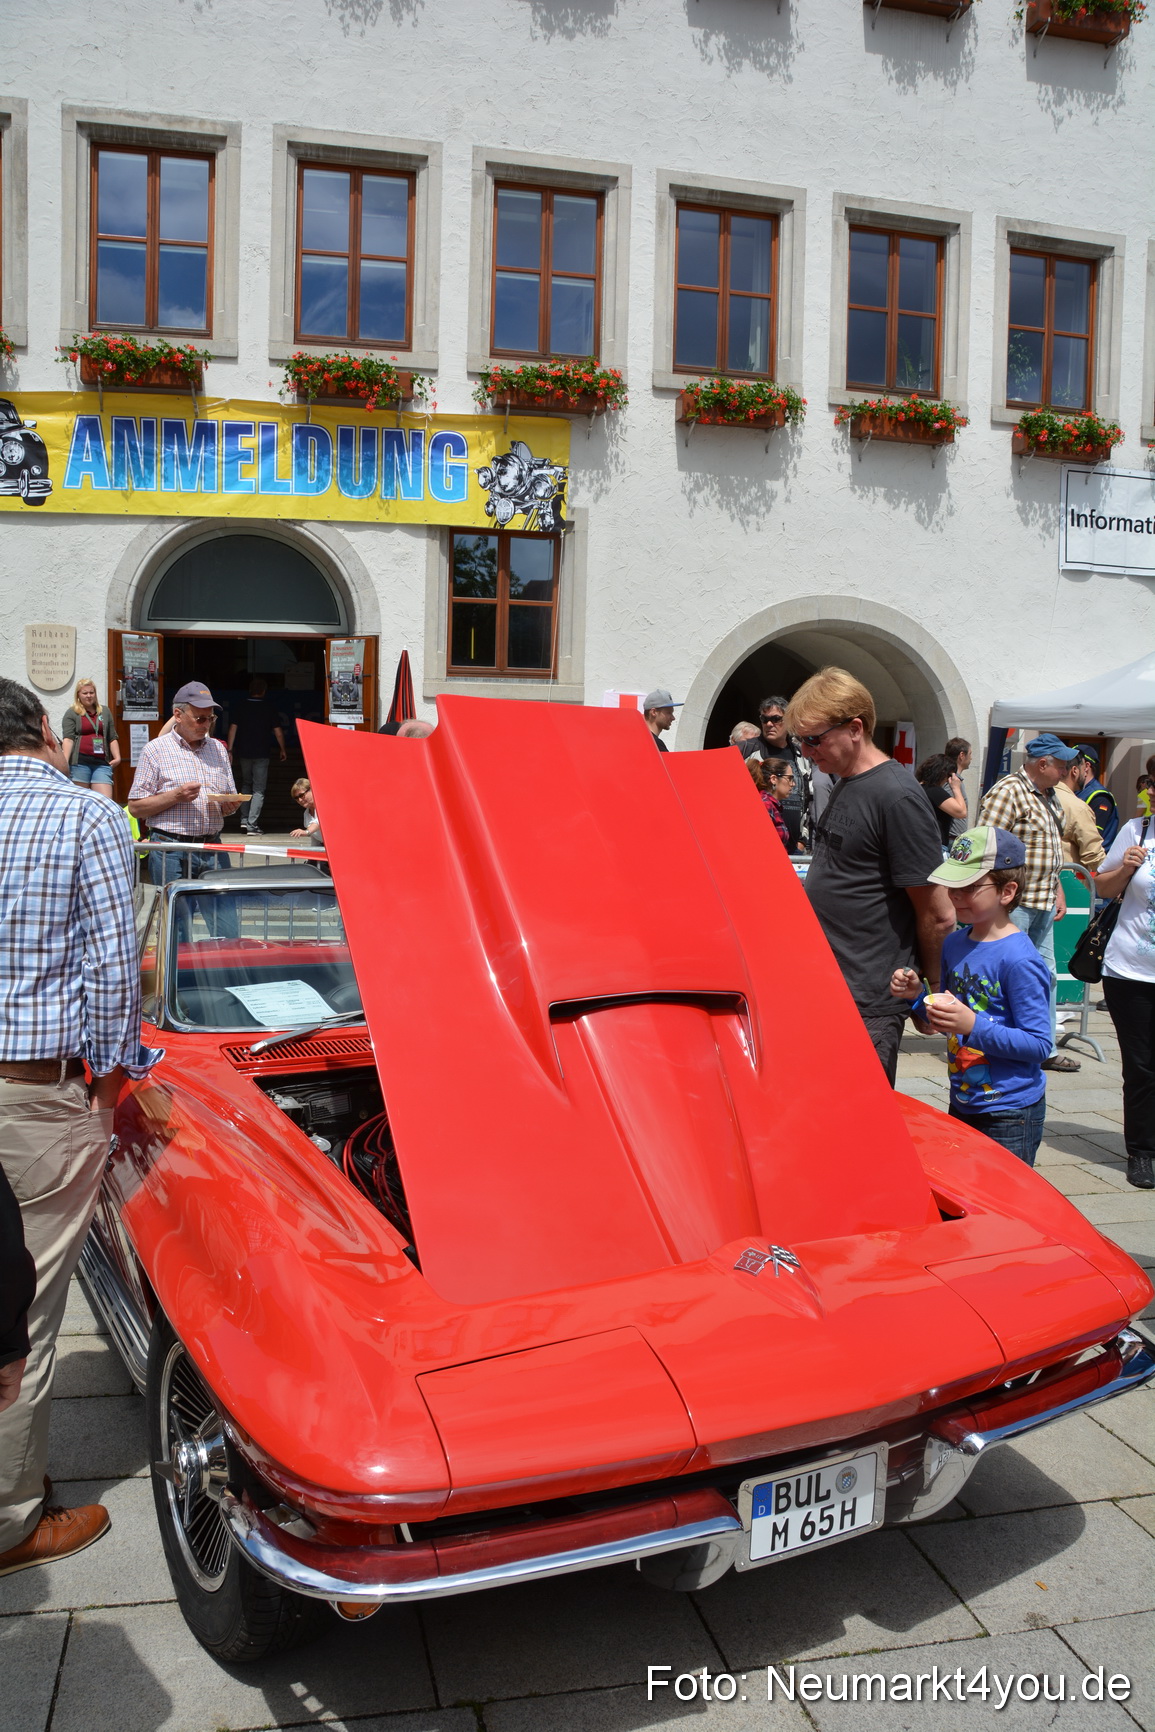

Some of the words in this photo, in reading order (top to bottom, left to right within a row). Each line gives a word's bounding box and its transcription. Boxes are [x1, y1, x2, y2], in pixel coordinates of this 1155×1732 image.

[63, 414, 469, 504] ANMELDUNG
[31, 629, 69, 638] Rathaus
[758, 1505, 766, 1516] D
[774, 1472, 831, 1515] BUL
[770, 1518, 790, 1552] M
[800, 1497, 857, 1542] 65H
